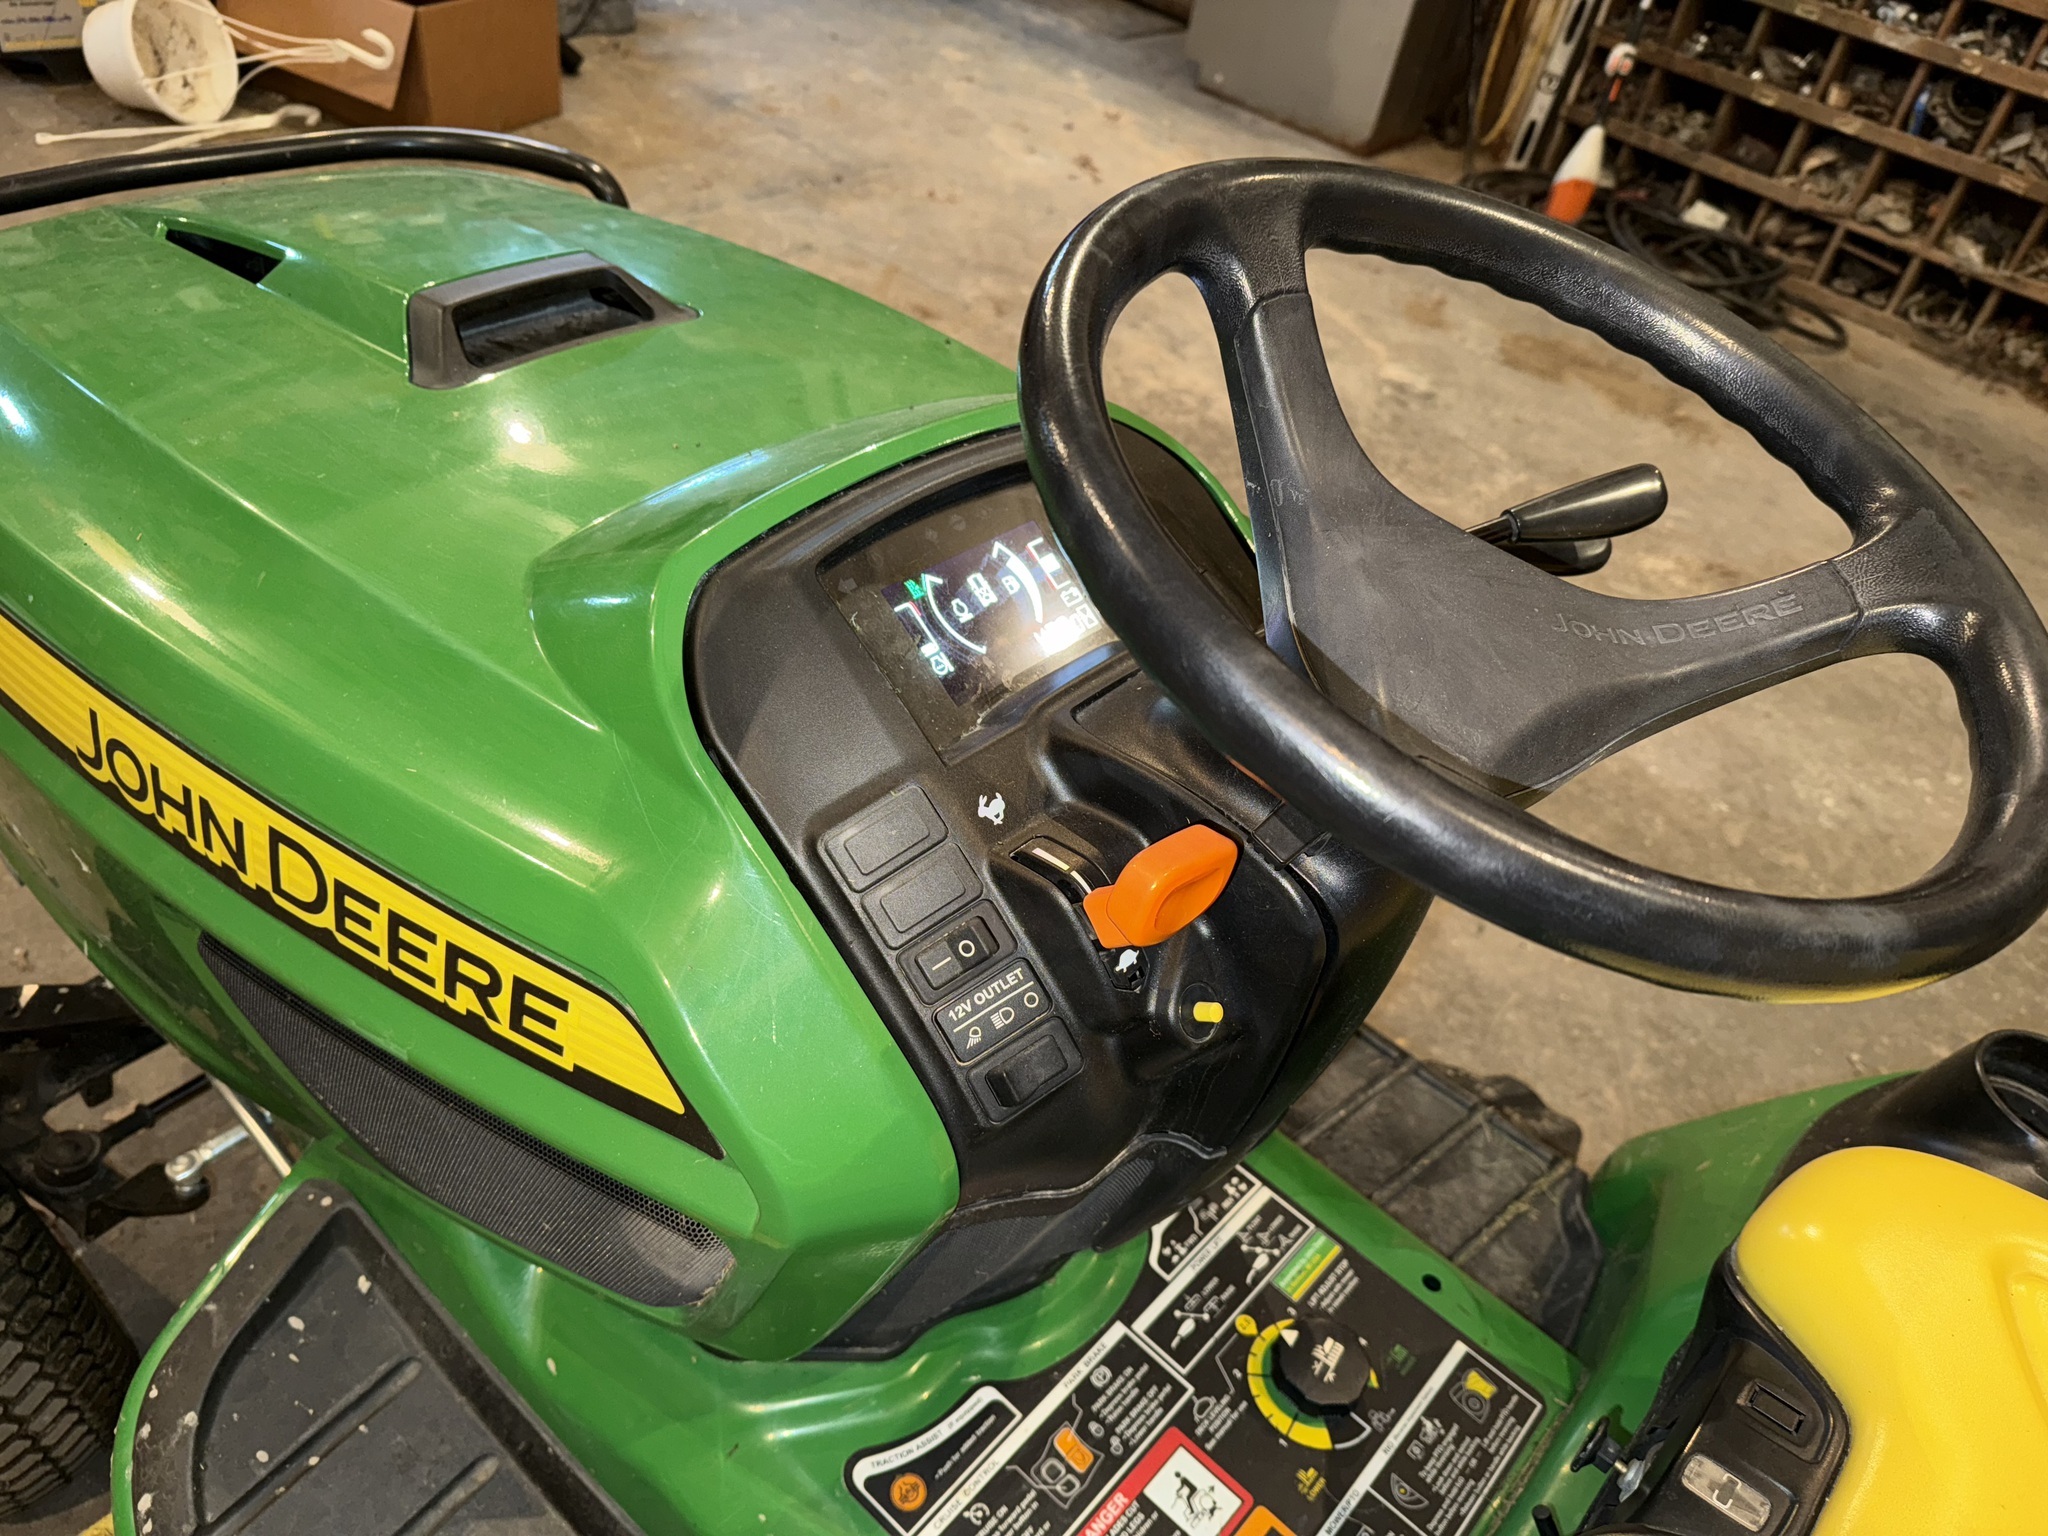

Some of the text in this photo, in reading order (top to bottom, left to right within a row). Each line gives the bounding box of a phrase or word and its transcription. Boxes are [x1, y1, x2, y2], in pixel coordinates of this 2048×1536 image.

[1551, 592, 1805, 646] JOHN DEERE
[76, 708, 571, 1057] JOHN DEERE
[949, 968, 1024, 1022] 12V OUTLET
[1062, 1341, 1108, 1389] PARK BRAKE
[1090, 1393, 1109, 1413] PARK
[1104, 1374, 1126, 1396] BRAKE
[1113, 1415, 1132, 1435] PARK
[1127, 1395, 1149, 1419] BRAKE
[869, 1446, 914, 1469] TRACTION
[914, 1428, 943, 1450] ASSIST
[932, 1457, 1000, 1530] CRUISE CONTROL
[994, 1503, 1009, 1519] ON
[1083, 1490, 1129, 1536] ANGER
